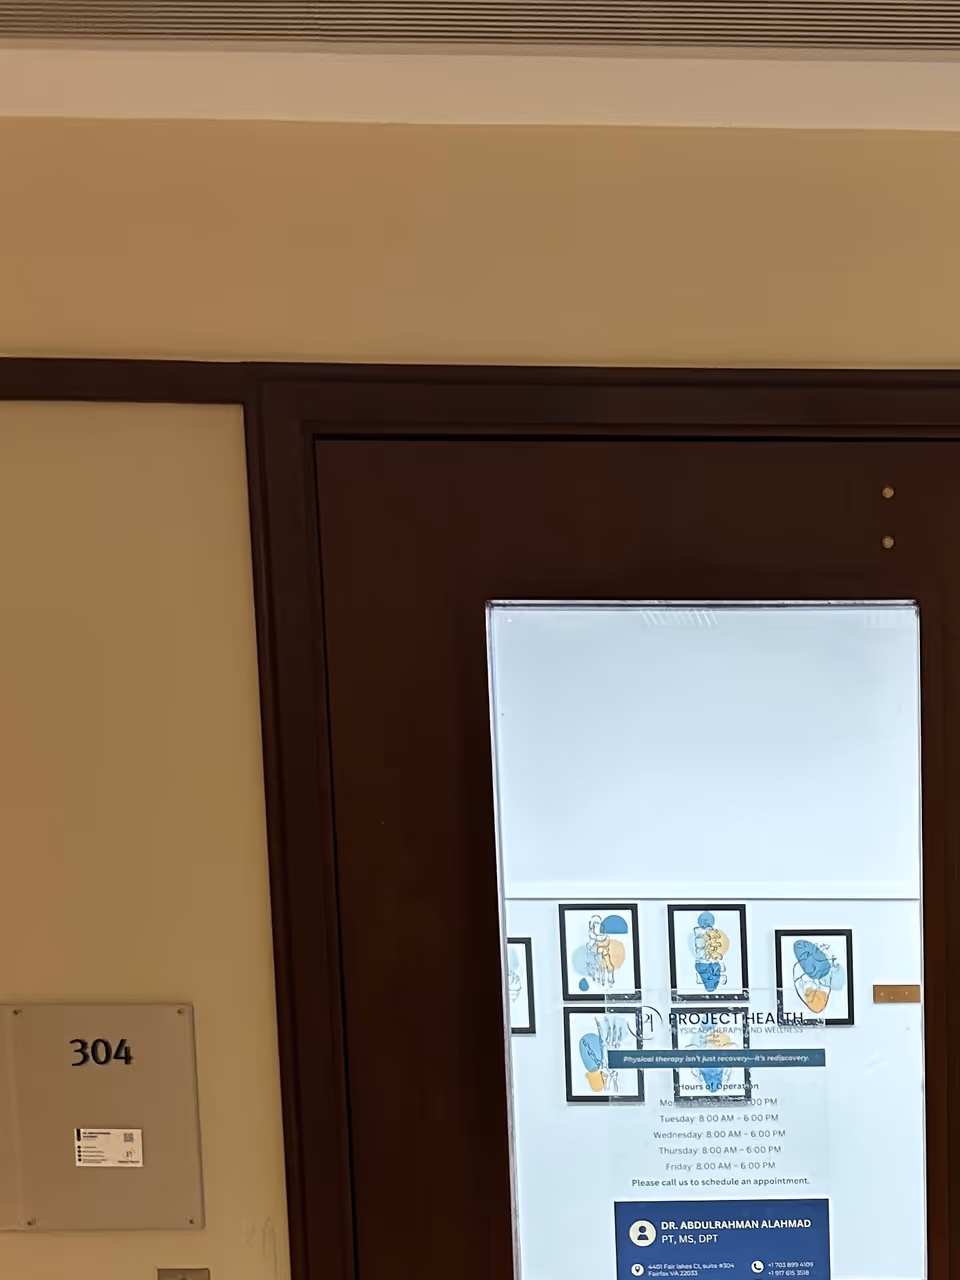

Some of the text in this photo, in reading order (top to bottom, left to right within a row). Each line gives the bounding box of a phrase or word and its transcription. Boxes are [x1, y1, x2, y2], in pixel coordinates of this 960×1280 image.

[668, 1012, 739, 1025] PROJECT
[69, 1038, 132, 1066] 304
[623, 1055, 654, 1063] Physical
[655, 1055, 684, 1063] therapy
[702, 1055, 716, 1063] just
[767, 1054, 809, 1063] rediscovery.
[705, 1082, 715, 1090] of
[765, 1098, 777, 1106] PM
[699, 1114, 719, 1122] 8:00
[721, 1114, 734, 1122] AM
[744, 1114, 763, 1122] 6:00
[706, 1130, 726, 1138] 8:00
[728, 1130, 741, 1138] AM
[750, 1130, 770, 1138] 6:00
[702, 1146, 721, 1154] 8:00
[723, 1146, 737, 1154] AM
[696, 1162, 716, 1170] 8:00
[718, 1162, 731, 1170] AM
[741, 1161, 760, 1169] 6:00
[763, 1161, 776, 1169] PM
[632, 1179, 660, 1187] Please
[662, 1178, 677, 1186] call
[701, 1178, 739, 1186] schedule
[753, 1177, 810, 1187] appointment.
[661, 1219, 811, 1230] DR. ABDULRAHMAN ALAHMAD
[661, 1234, 718, 1244] PT, MS, DPT
